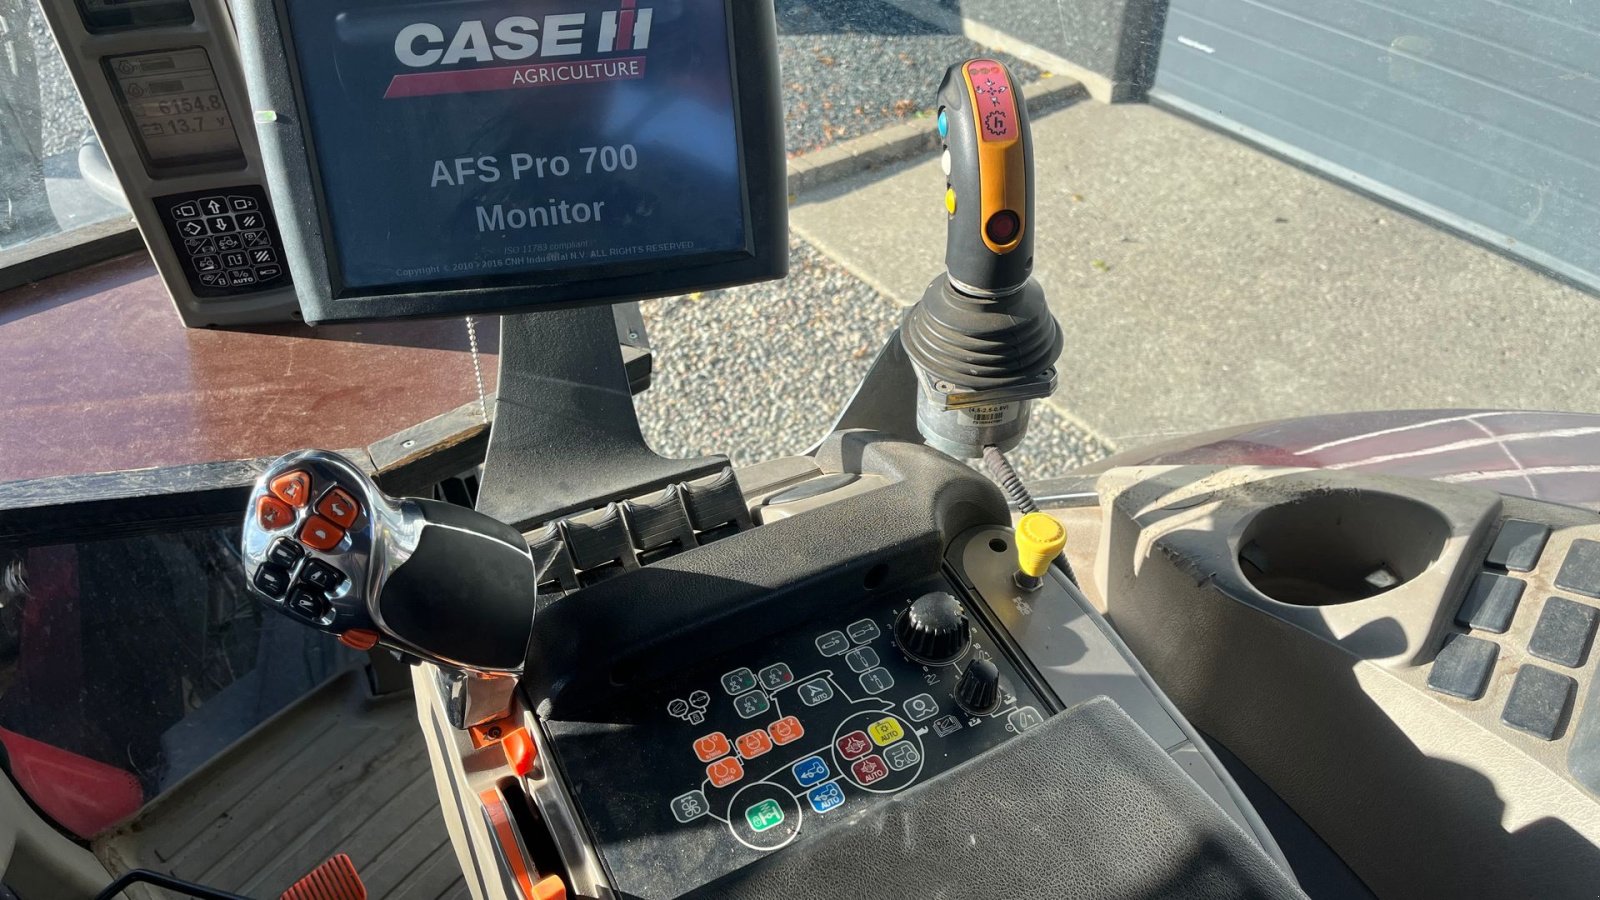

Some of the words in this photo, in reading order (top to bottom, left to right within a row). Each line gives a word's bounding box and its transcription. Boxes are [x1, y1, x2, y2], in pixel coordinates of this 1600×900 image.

[393, 13, 586, 68] CASE
[512, 60, 640, 86] AGRICULTURE
[159, 95, 221, 115] 6154.8
[167, 117, 204, 134] 13.7
[430, 155, 501, 188] AFS
[510, 152, 571, 180] Pro
[579, 144, 638, 174] 700
[475, 198, 605, 233] Monitor
[504, 245, 520, 256] ISO
[549, 240, 588, 252] compliant
[395, 265, 440, 278] Copyright
[504, 256, 525, 266] CNH
[526, 252, 569, 265] Industrial
[590, 249, 608, 259] ALL
[609, 246, 644, 256] RIGHTS
[645, 240, 694, 253] RESERVED
[232, 276, 254, 285] AUTO
[812, 692, 829, 704] AUTO
[881, 730, 900, 743] AUTO
[865, 769, 885, 783] AUTO
[820, 796, 840, 810] AUTO
